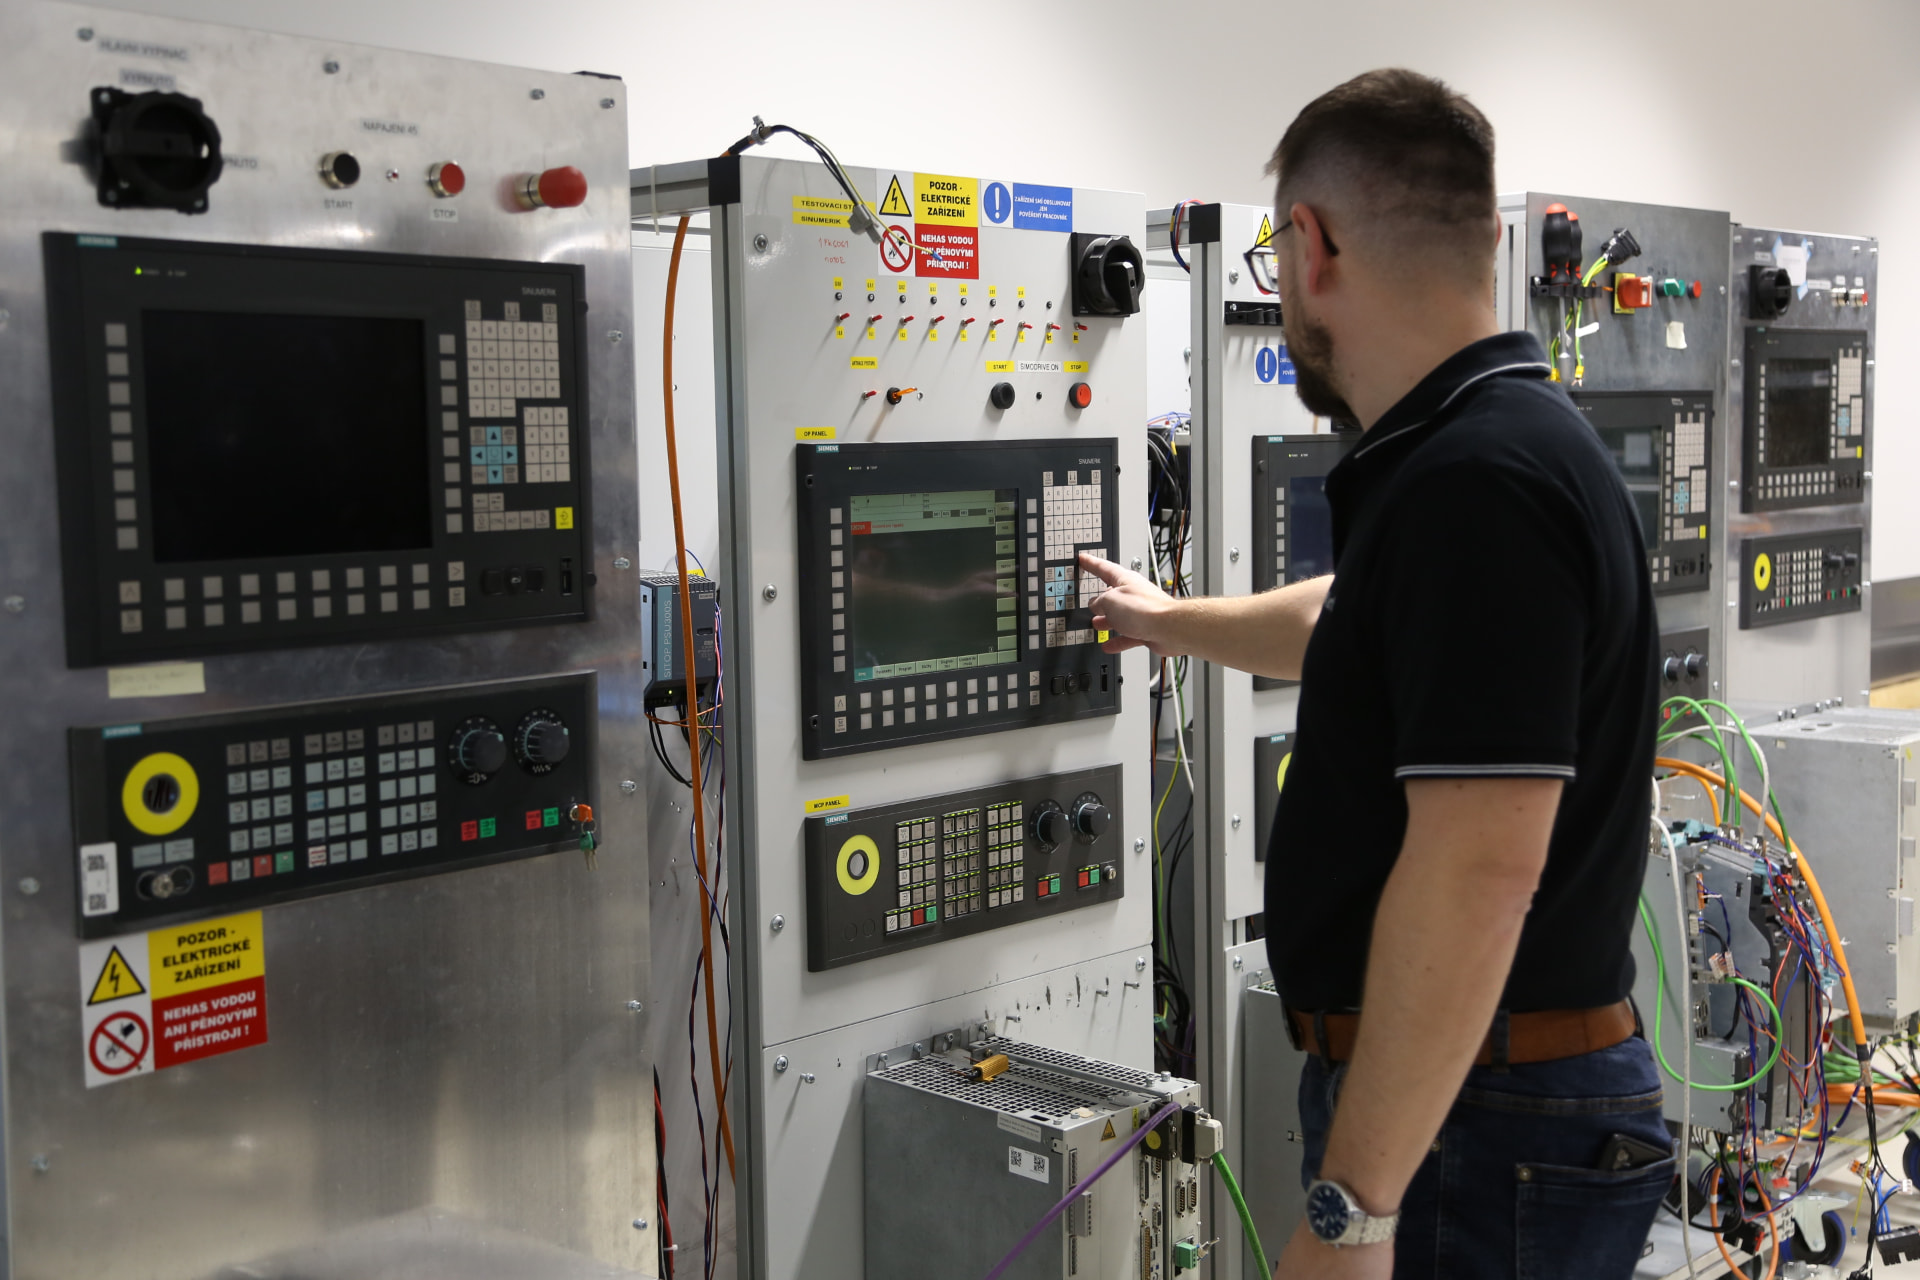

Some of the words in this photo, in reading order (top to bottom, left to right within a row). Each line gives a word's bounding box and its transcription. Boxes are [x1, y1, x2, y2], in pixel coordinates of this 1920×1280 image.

[929, 181, 957, 191] POZOR
[801, 200, 842, 209] TESTOVACI
[921, 194, 971, 205] ELEKTRICKÉ
[433, 209, 456, 219] STOP
[927, 205, 965, 218] ZAŘÍZENÍ
[1042, 212, 1067, 220] PRACOVNÍK
[801, 216, 841, 224] SINUMERIK
[921, 234, 946, 243] NEHAS
[948, 236, 973, 245] VODOU
[936, 246, 974, 257] PĚNOVÝMI
[1051, 363, 1059, 371] ON
[664, 600, 672, 645] PSU300S
[664, 648, 672, 678] SITOP
[825, 799, 841, 807] PANEL
[826, 814, 848, 823] SIEMENS
[177, 928, 227, 948] POZOR
[162, 936, 252, 968] ELEKTRICKÉ
[174, 954, 241, 983] ZAŘÍZENÍ
[163, 1001, 208, 1022] NEHAS
[211, 990, 256, 1010] VODOU
[163, 1022, 187, 1039] ANI
[190, 1006, 257, 1032] PĚNOVÝMI
[173, 1026, 242, 1053] PŘÍSTROJI
